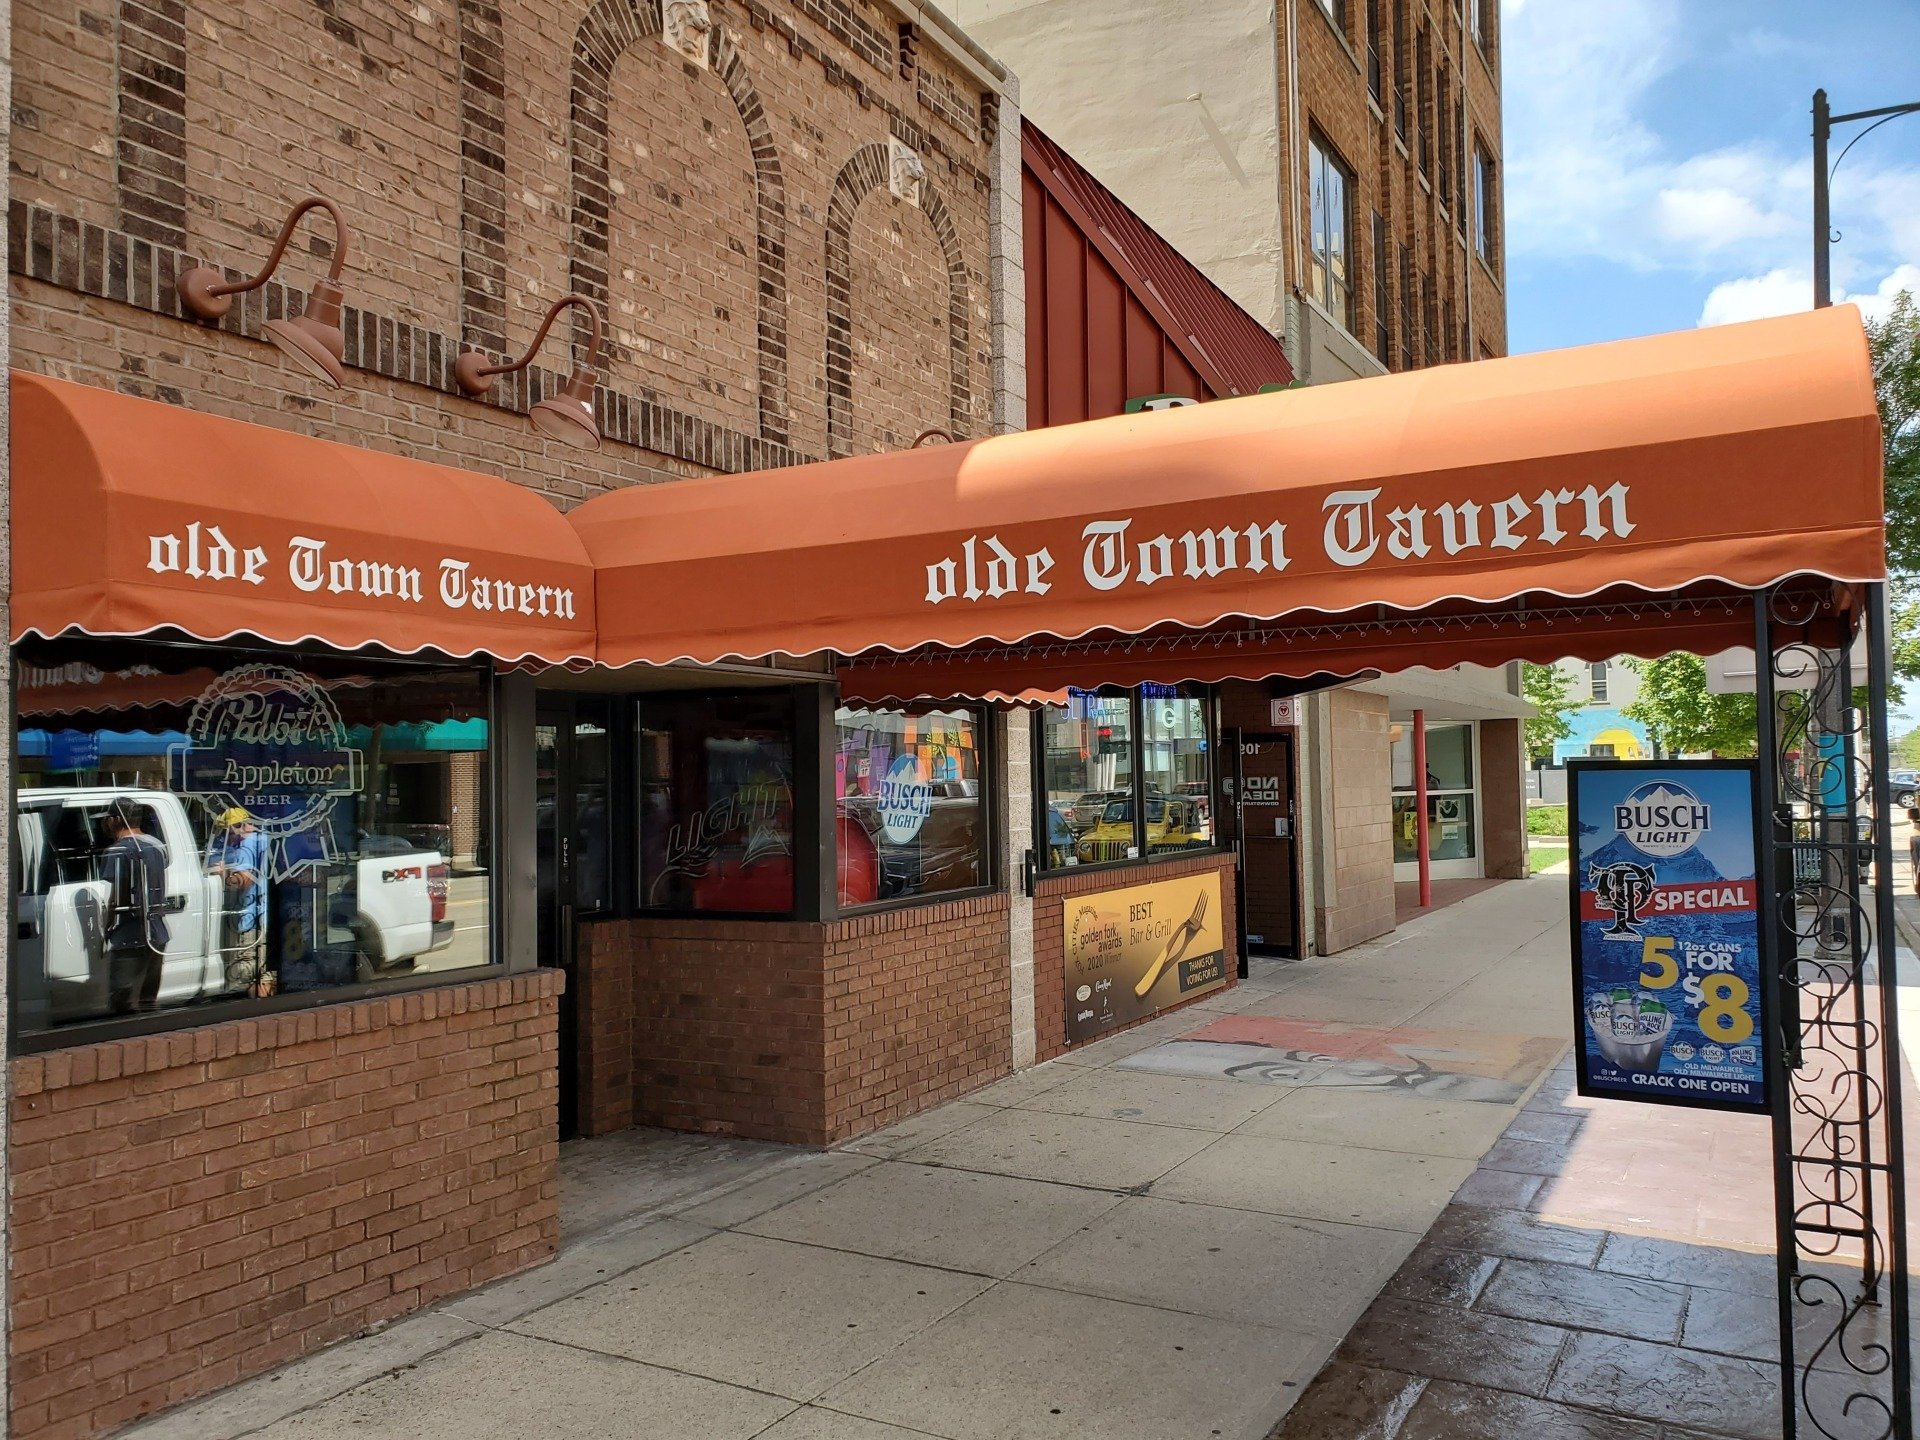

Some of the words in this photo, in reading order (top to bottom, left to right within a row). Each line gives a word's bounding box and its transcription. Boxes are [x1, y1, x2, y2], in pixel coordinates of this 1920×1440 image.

[924, 534, 1056, 605] olde
[1081, 517, 1292, 591] Town
[1321, 479, 1639, 567] Tavern
[147, 521, 269, 585] olde
[288, 536, 424, 603] Town
[438, 558, 577, 620] Tavern
[221, 758, 334, 790] Appleton
[243, 795, 292, 806] BEER
[880, 781, 931, 816] BUSCH
[887, 813, 918, 829] LIGHT
[1615, 805, 1709, 830] BUSCH
[1636, 831, 1691, 843] LIGHT
[1654, 887, 1750, 911] SPECIAL
[1130, 901, 1154, 922] BEST
[1080, 926, 1103, 950] golden
[1104, 922, 1118, 940] fork
[1130, 927, 1143, 946] Bar
[1146, 923, 1154, 941] &
[1154, 918, 1172, 939] Grill
[1098, 933, 1122, 953] awards
[1088, 954, 1104, 971] 2020
[1188, 958, 1206, 972] THANKS
[1205, 955, 1214, 967] FOR
[1639, 936, 1679, 990] 5
[1678, 941, 1706, 951] 12oz
[1708, 942, 1742, 953] CANS
[1686, 951, 1735, 971] FOR
[1186, 971, 1203, 986] VOTING
[1202, 970, 1211, 981] FOR
[1612, 1021, 1639, 1032] BUSCH
[1670, 1046, 1696, 1056] BUSCH
[1700, 1049, 1725, 1058] BUSCH
[1700, 1064, 1744, 1074] MILWAUKEE
[1733, 1073, 1756, 1081] LIGHT
[1631, 1073, 1675, 1088] CRACK
[1678, 1078, 1708, 1091] ONE
[1710, 1080, 1750, 1094] OPEN
